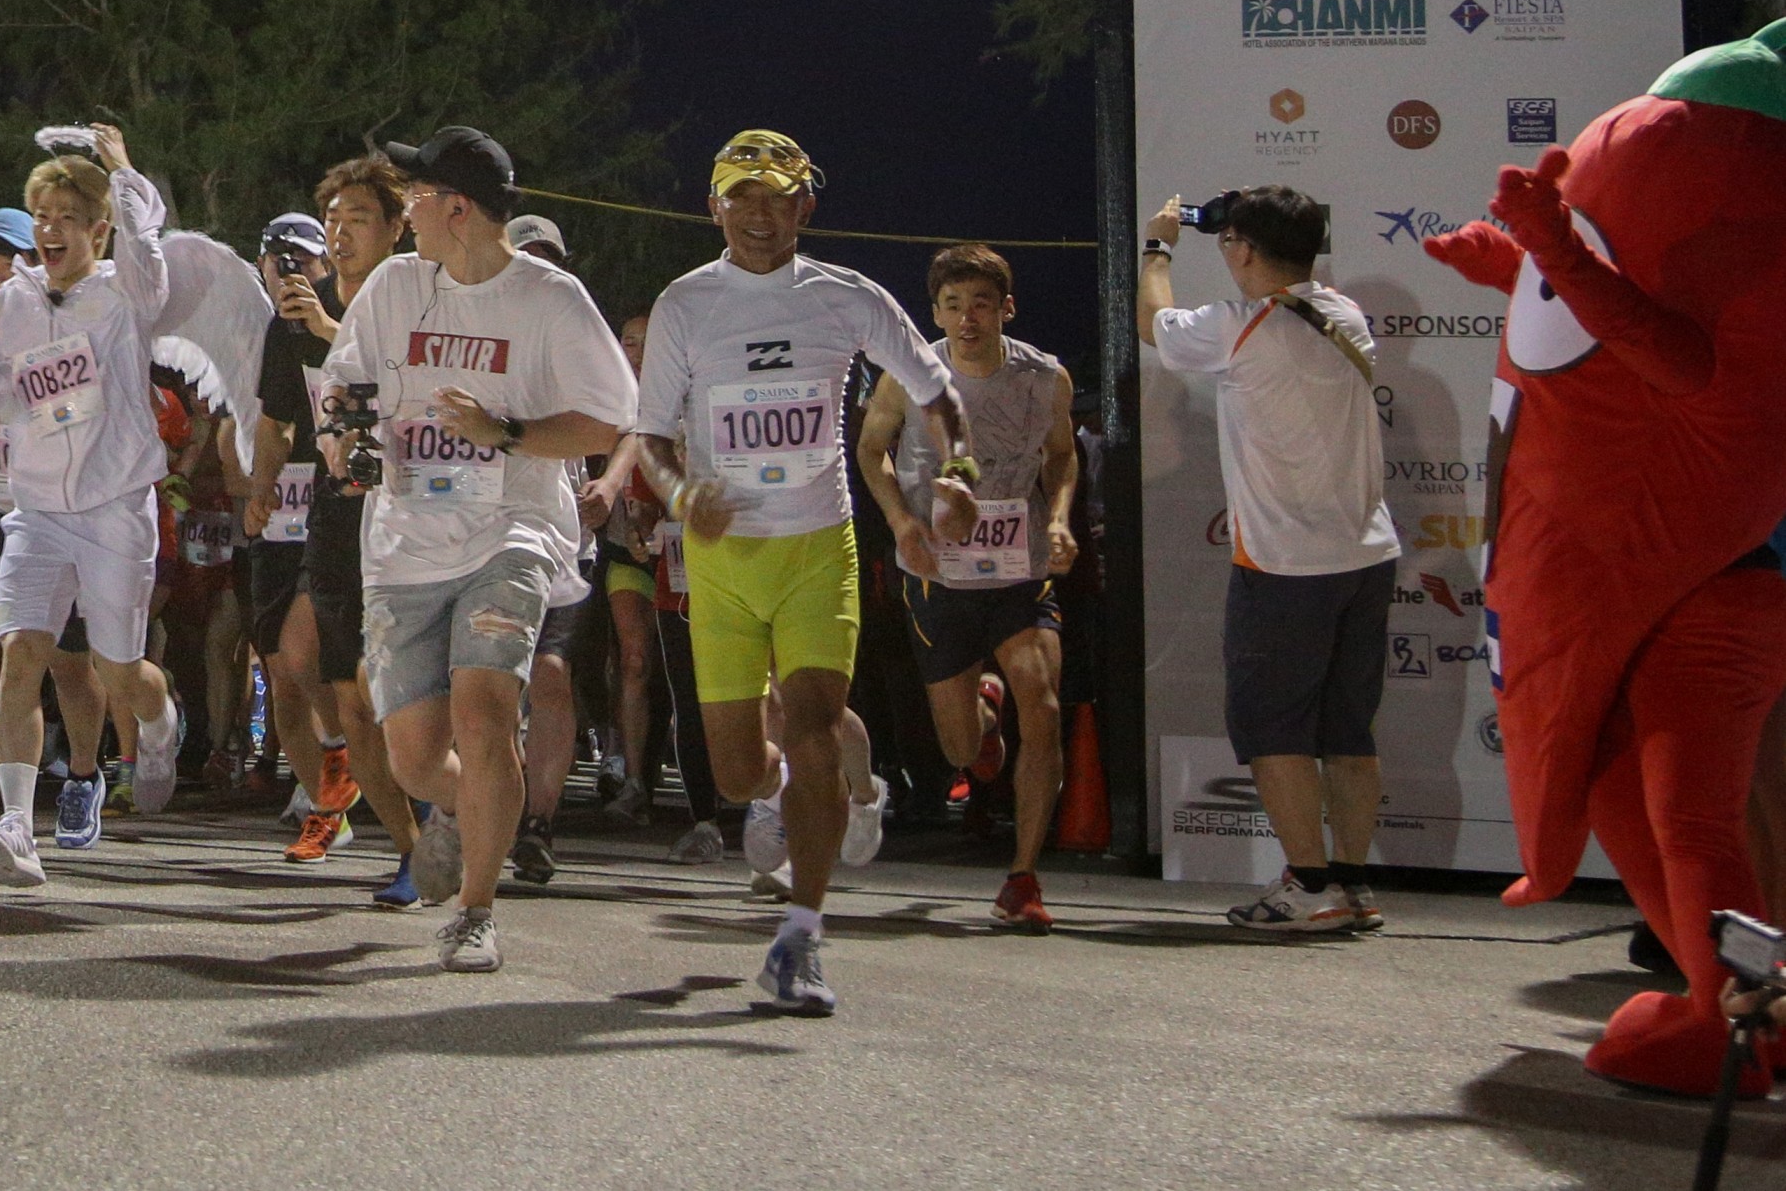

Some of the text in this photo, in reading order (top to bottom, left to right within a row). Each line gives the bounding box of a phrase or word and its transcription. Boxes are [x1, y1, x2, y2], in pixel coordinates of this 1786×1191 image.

[1243, 39, 1264, 49] HOTEL
[1265, 38, 1307, 48] ASSOCIATION
[1332, 37, 1367, 47] NORTHERN
[1393, 116, 1437, 135] DFS
[1255, 130, 1320, 143] HYATT
[1255, 144, 1320, 156] REGENCY
[1383, 315, 1506, 335] SPONSO
[17, 354, 91, 404] 10822
[758, 387, 799, 398] SAIPAN
[722, 405, 824, 449] 10007
[1414, 483, 1465, 494] SAIPAN
[946, 517, 1021, 548] 487
[1174, 810, 1268, 828] SKECHE
[1383, 819, 1425, 830] Rentals
[1174, 825, 1278, 838] PERFORMAN
